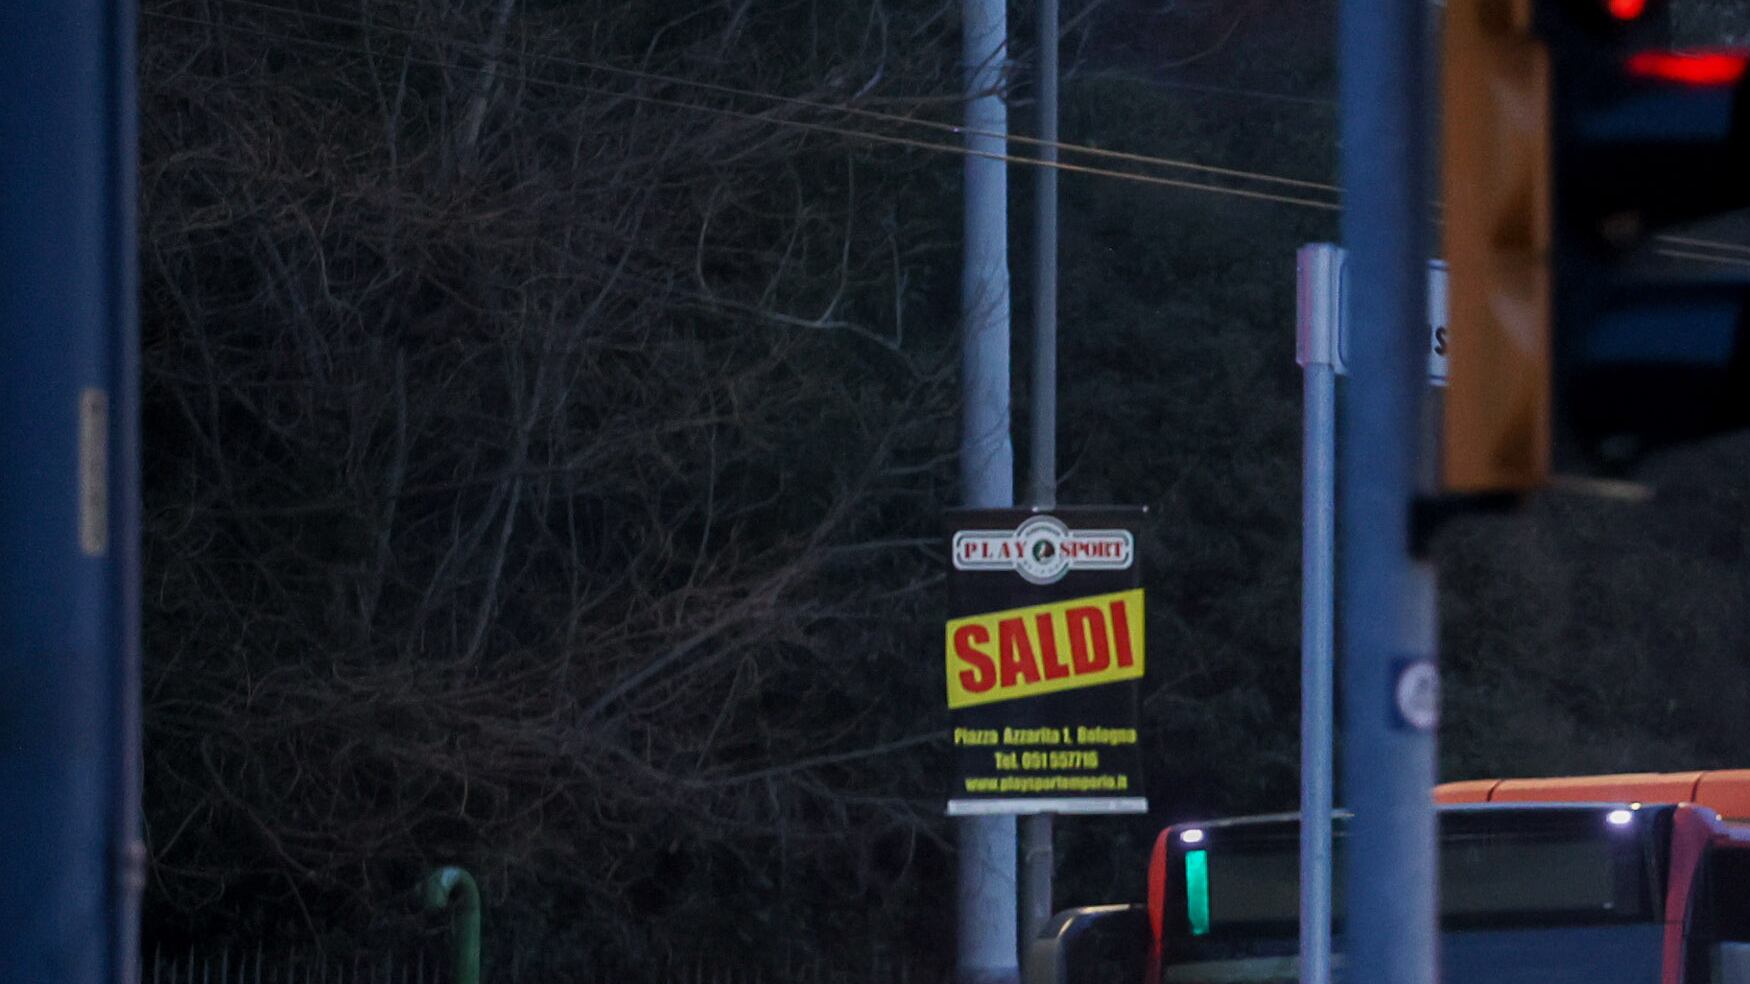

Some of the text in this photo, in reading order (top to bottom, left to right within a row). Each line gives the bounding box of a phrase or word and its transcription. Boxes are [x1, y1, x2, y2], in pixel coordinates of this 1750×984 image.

[963, 540, 1124, 559] PLAY SPORT
[953, 600, 1134, 694] SALDI
[954, 726, 999, 744] Piazza
[1076, 725, 1138, 746] Bologna
